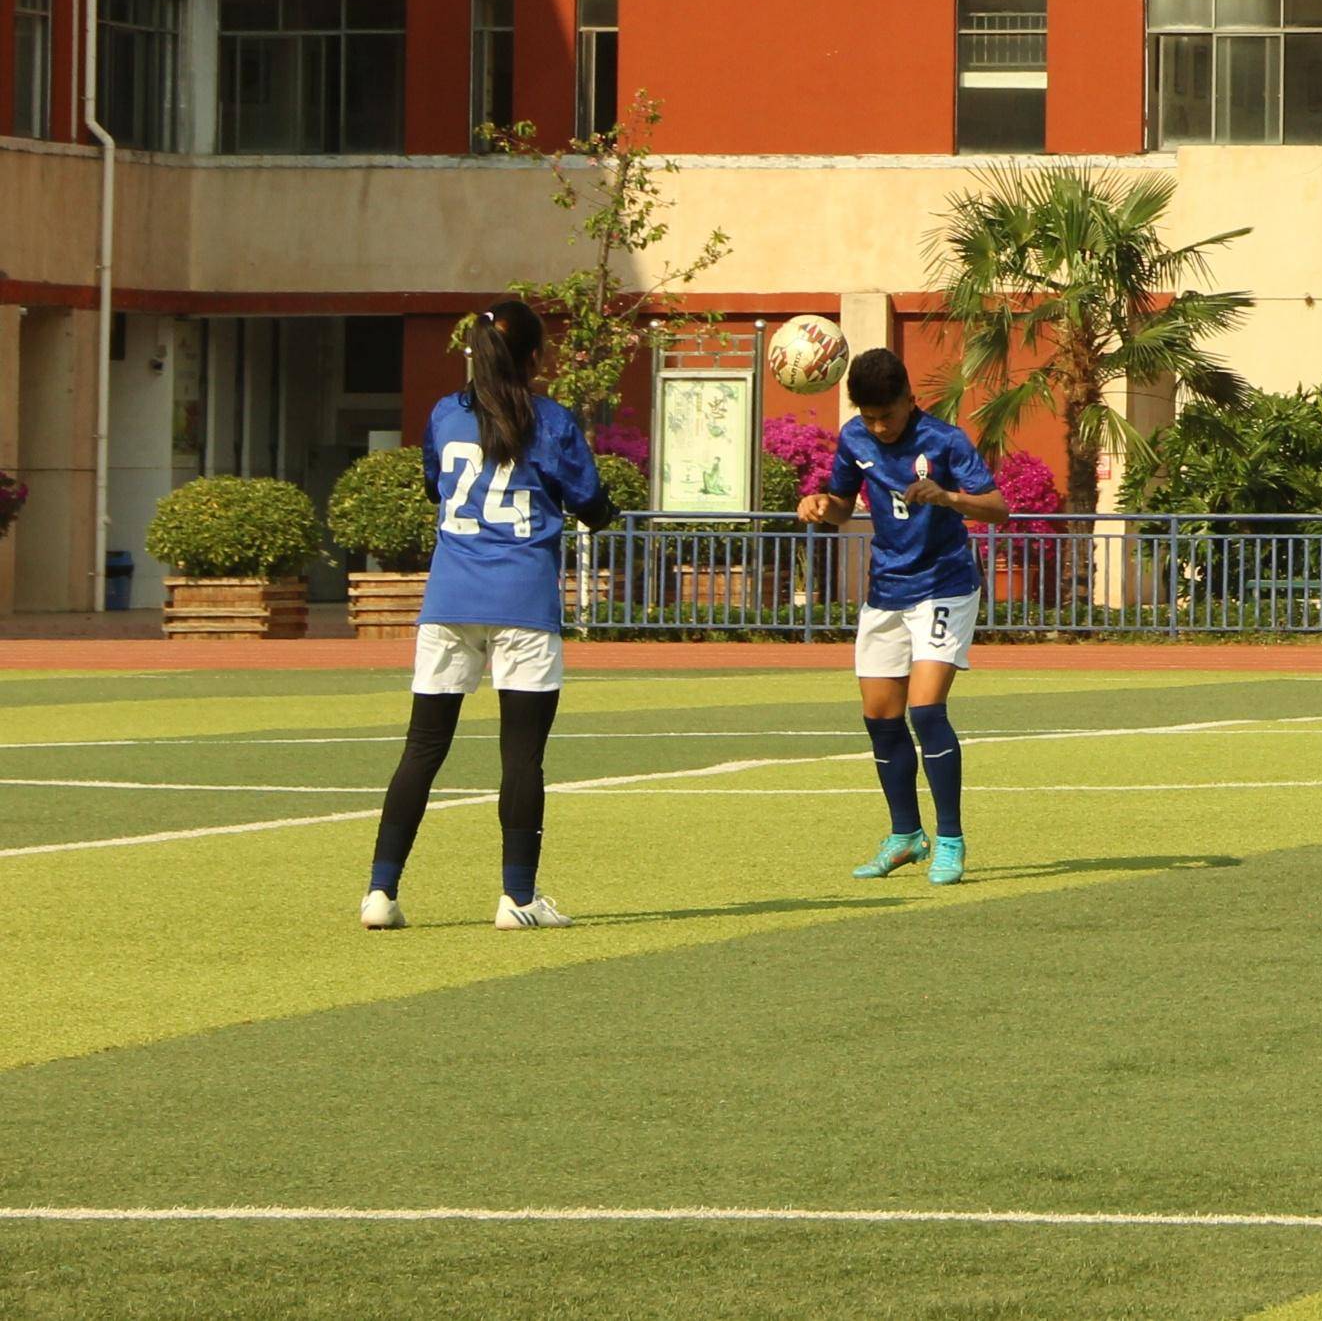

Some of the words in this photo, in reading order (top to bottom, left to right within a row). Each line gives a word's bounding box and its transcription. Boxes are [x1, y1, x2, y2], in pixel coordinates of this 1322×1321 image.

[440, 441, 531, 538] 24
[889, 490, 910, 520] 6
[931, 606, 950, 639] 6
